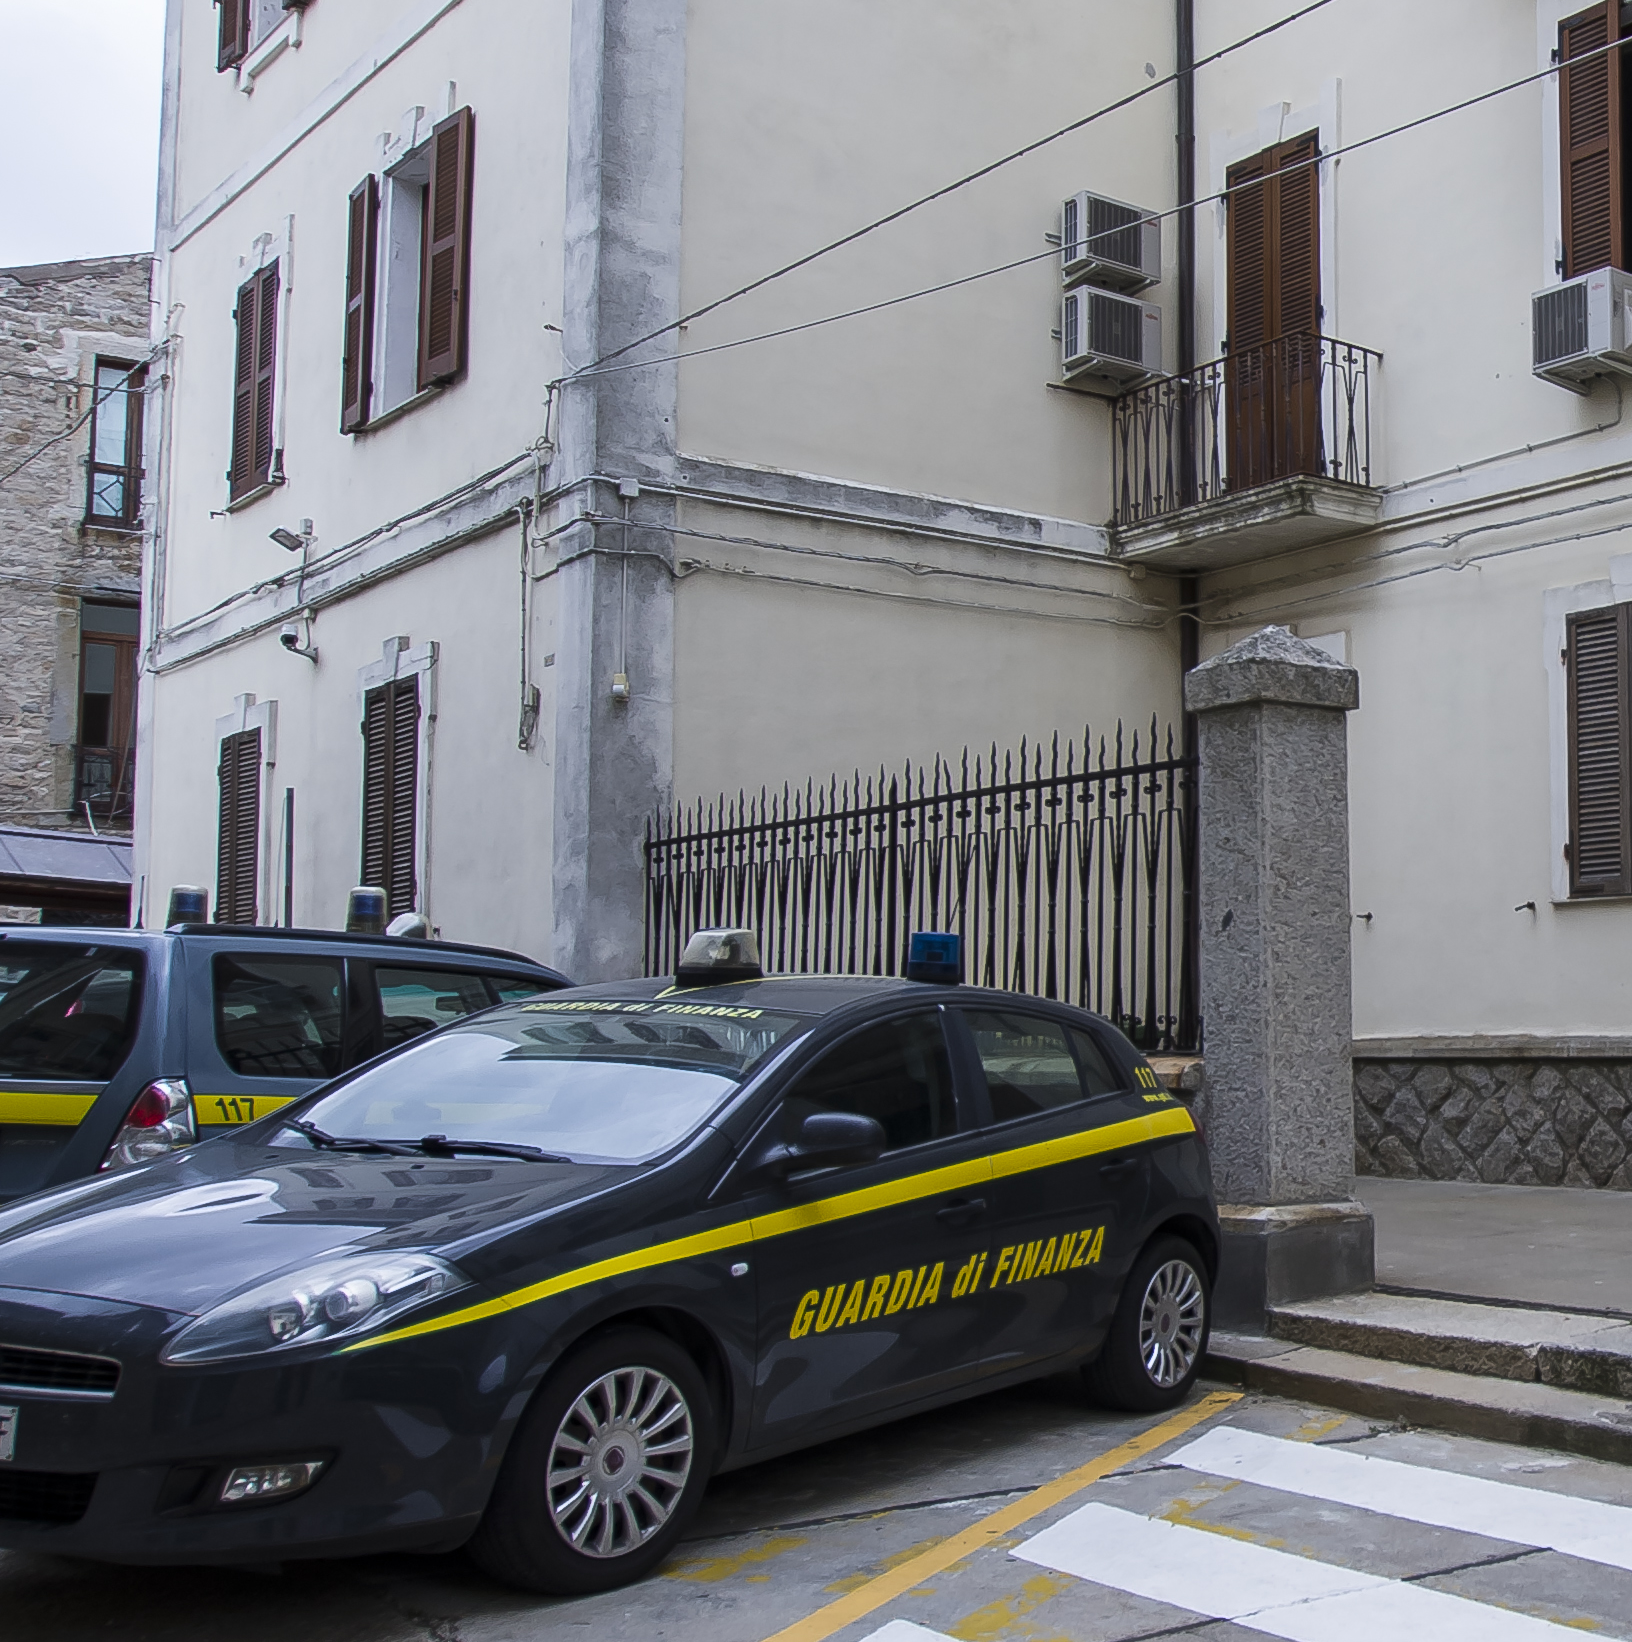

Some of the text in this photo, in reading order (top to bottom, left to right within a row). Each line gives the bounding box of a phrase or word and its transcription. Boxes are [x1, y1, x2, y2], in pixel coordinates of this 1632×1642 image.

[652, 1002, 765, 1019] FINANZA
[1134, 1066, 1158, 1089] 117
[214, 1097, 255, 1122] 117
[788, 1225, 1106, 1340] GUARDIA di FINANZA
